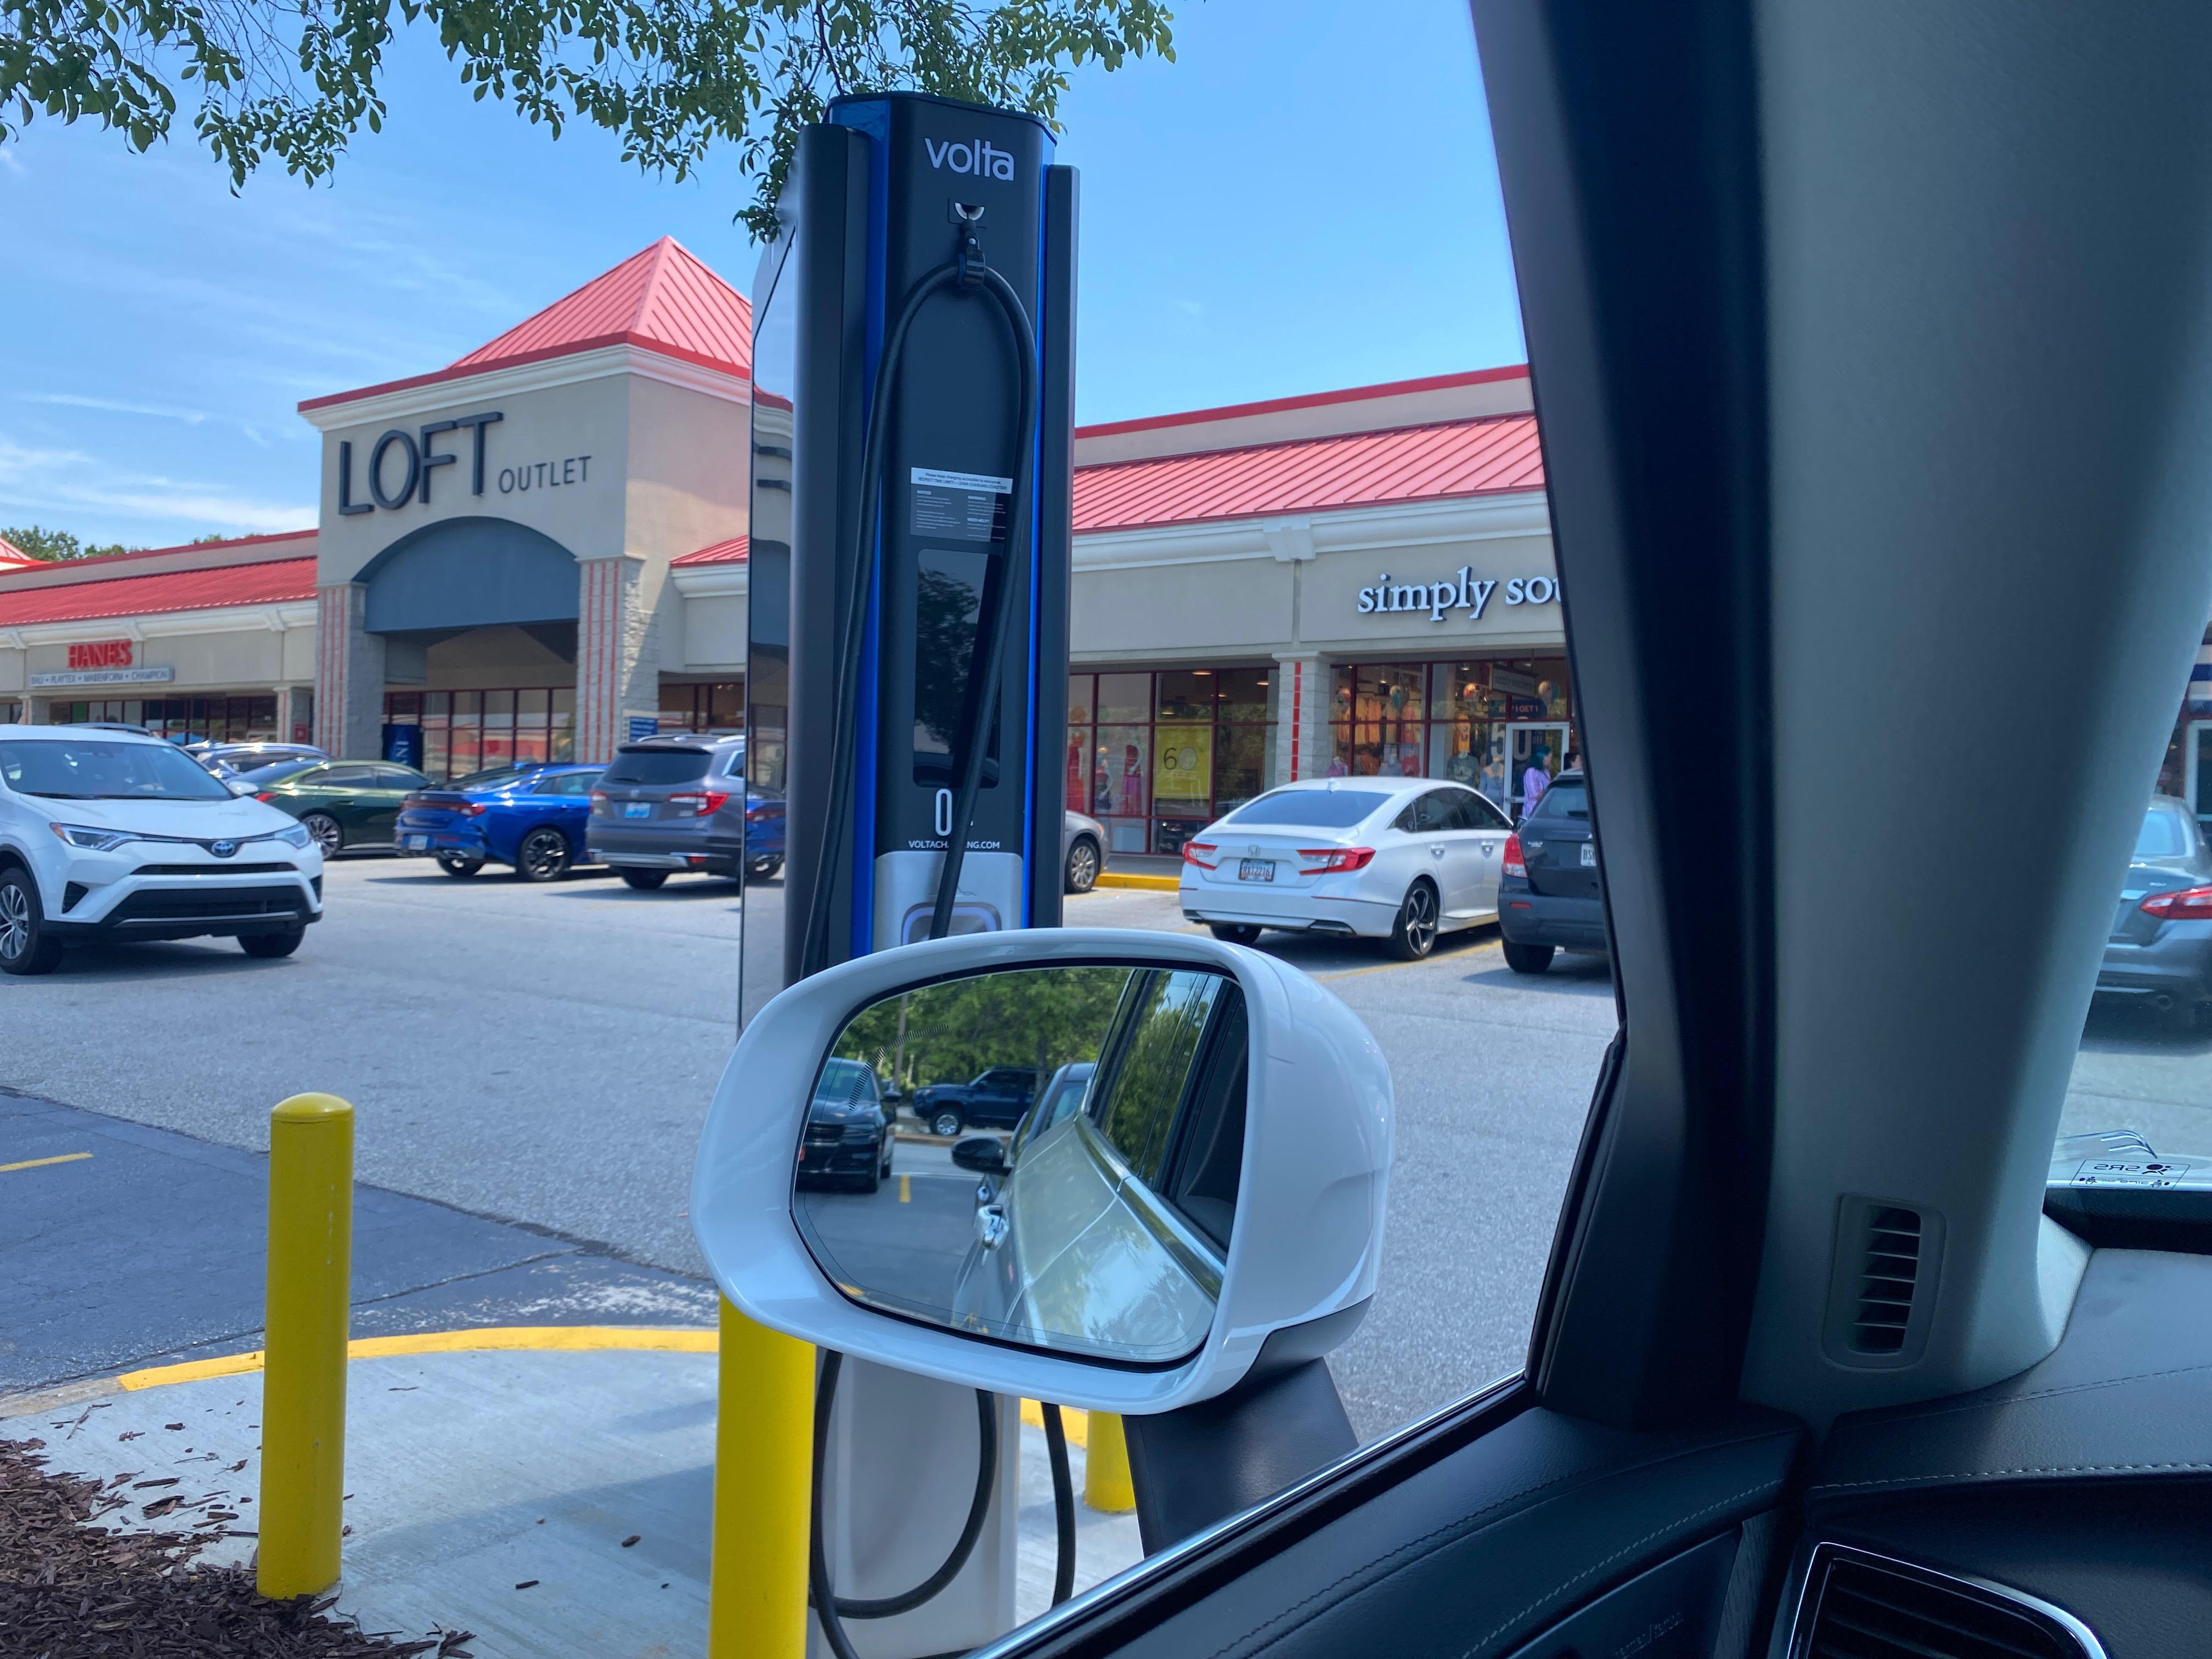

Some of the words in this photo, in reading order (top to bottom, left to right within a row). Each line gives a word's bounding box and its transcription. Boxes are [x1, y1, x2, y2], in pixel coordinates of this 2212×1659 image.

[924, 138, 1015, 182] volta
[339, 411, 504, 515] LOFT
[499, 456, 592, 494] OUTLET
[1357, 566, 1499, 622] simply
[67, 639, 133, 669] HANES
[909, 840, 1001, 849] VOLTACHNG.COM
